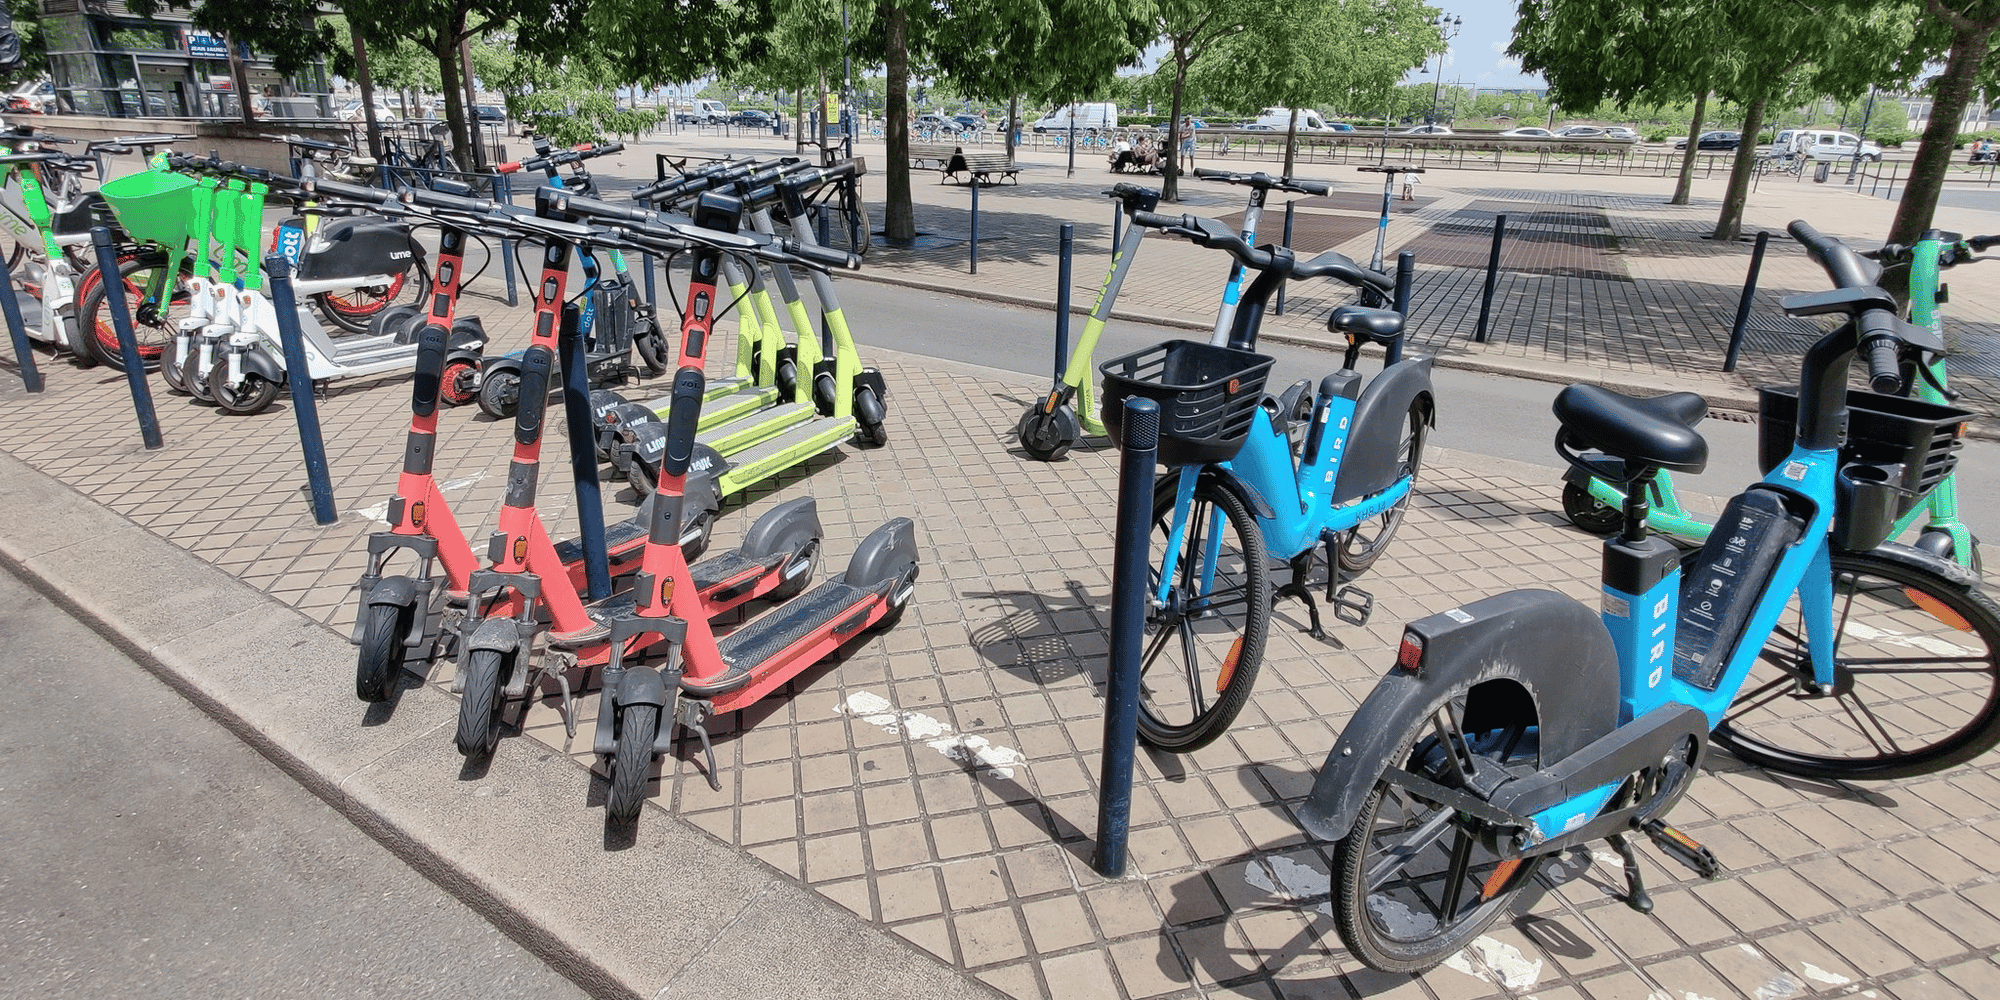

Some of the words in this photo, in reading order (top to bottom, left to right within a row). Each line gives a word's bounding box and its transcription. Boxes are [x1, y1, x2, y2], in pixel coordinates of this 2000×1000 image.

[584, 308, 594, 328] dott
[645, 436, 666, 453] LIN
[1324, 416, 1347, 483] BIRD
[1649, 593, 1669, 688] BIRD
